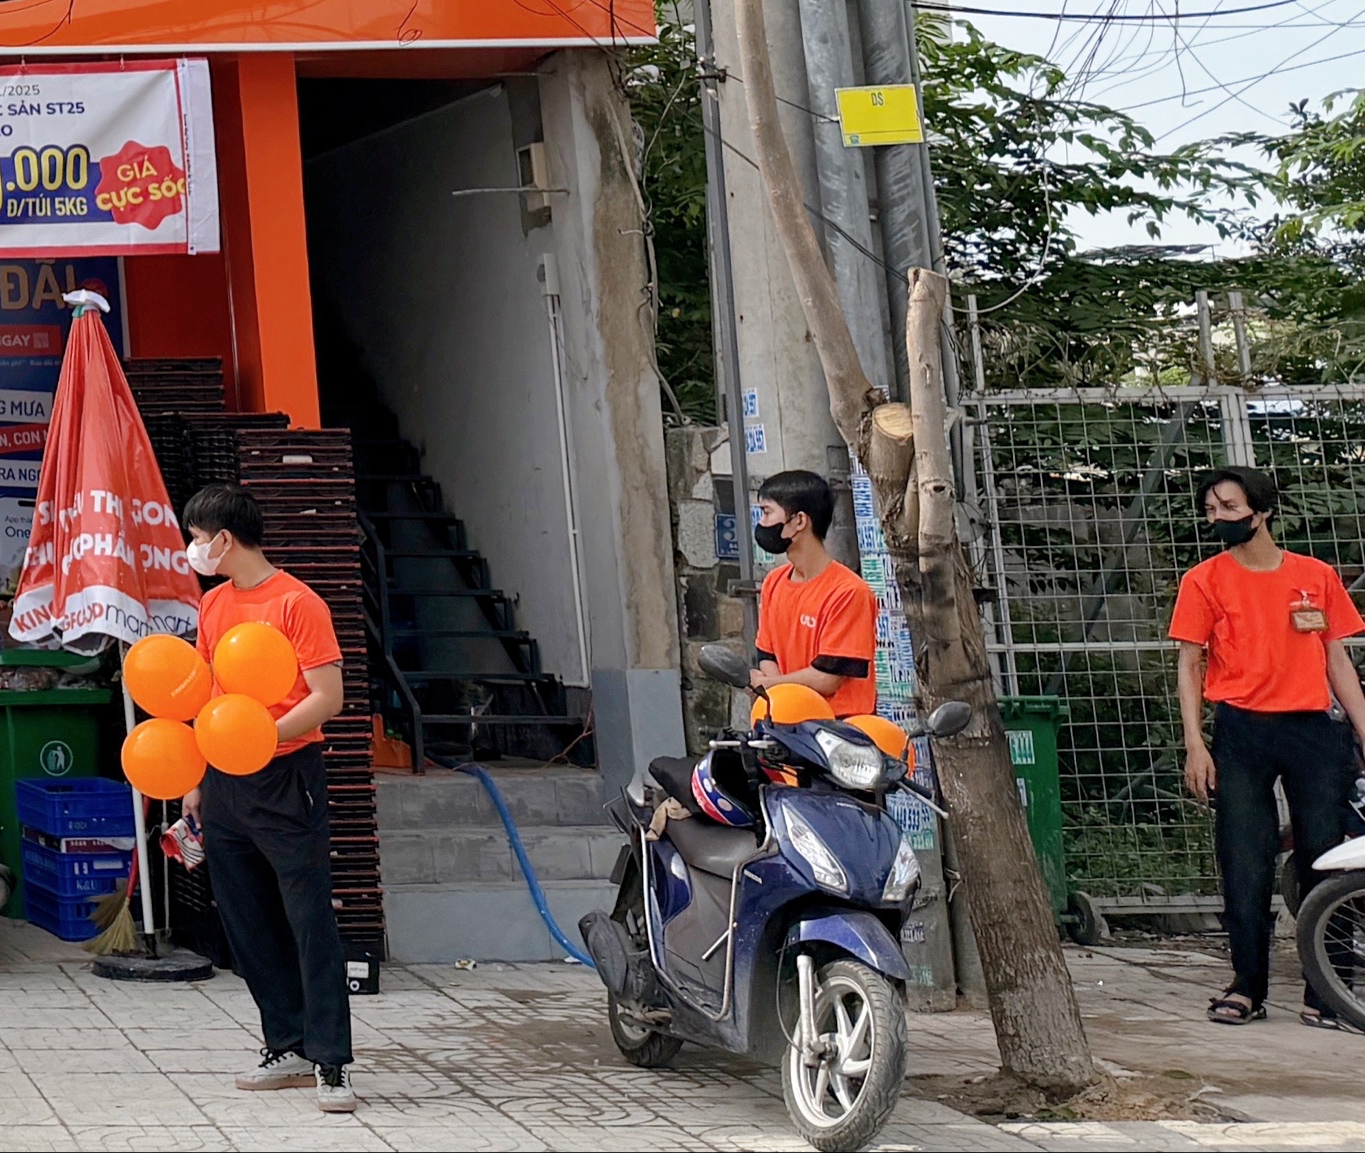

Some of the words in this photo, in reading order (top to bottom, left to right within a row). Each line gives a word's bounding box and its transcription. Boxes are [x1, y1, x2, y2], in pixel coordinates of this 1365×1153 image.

[871, 92, 884, 106] DS
[7, 100, 42, 116] SẢN
[46, 101, 86, 115] ST25
[116, 155, 158, 183] GIÁ
[55, 195, 88, 217] 5KG
[95, 185, 144, 213] CỰC
[10, 401, 45, 417] MƯA
[13, 429, 40, 446] CON
[0, 467, 16, 481] RA
